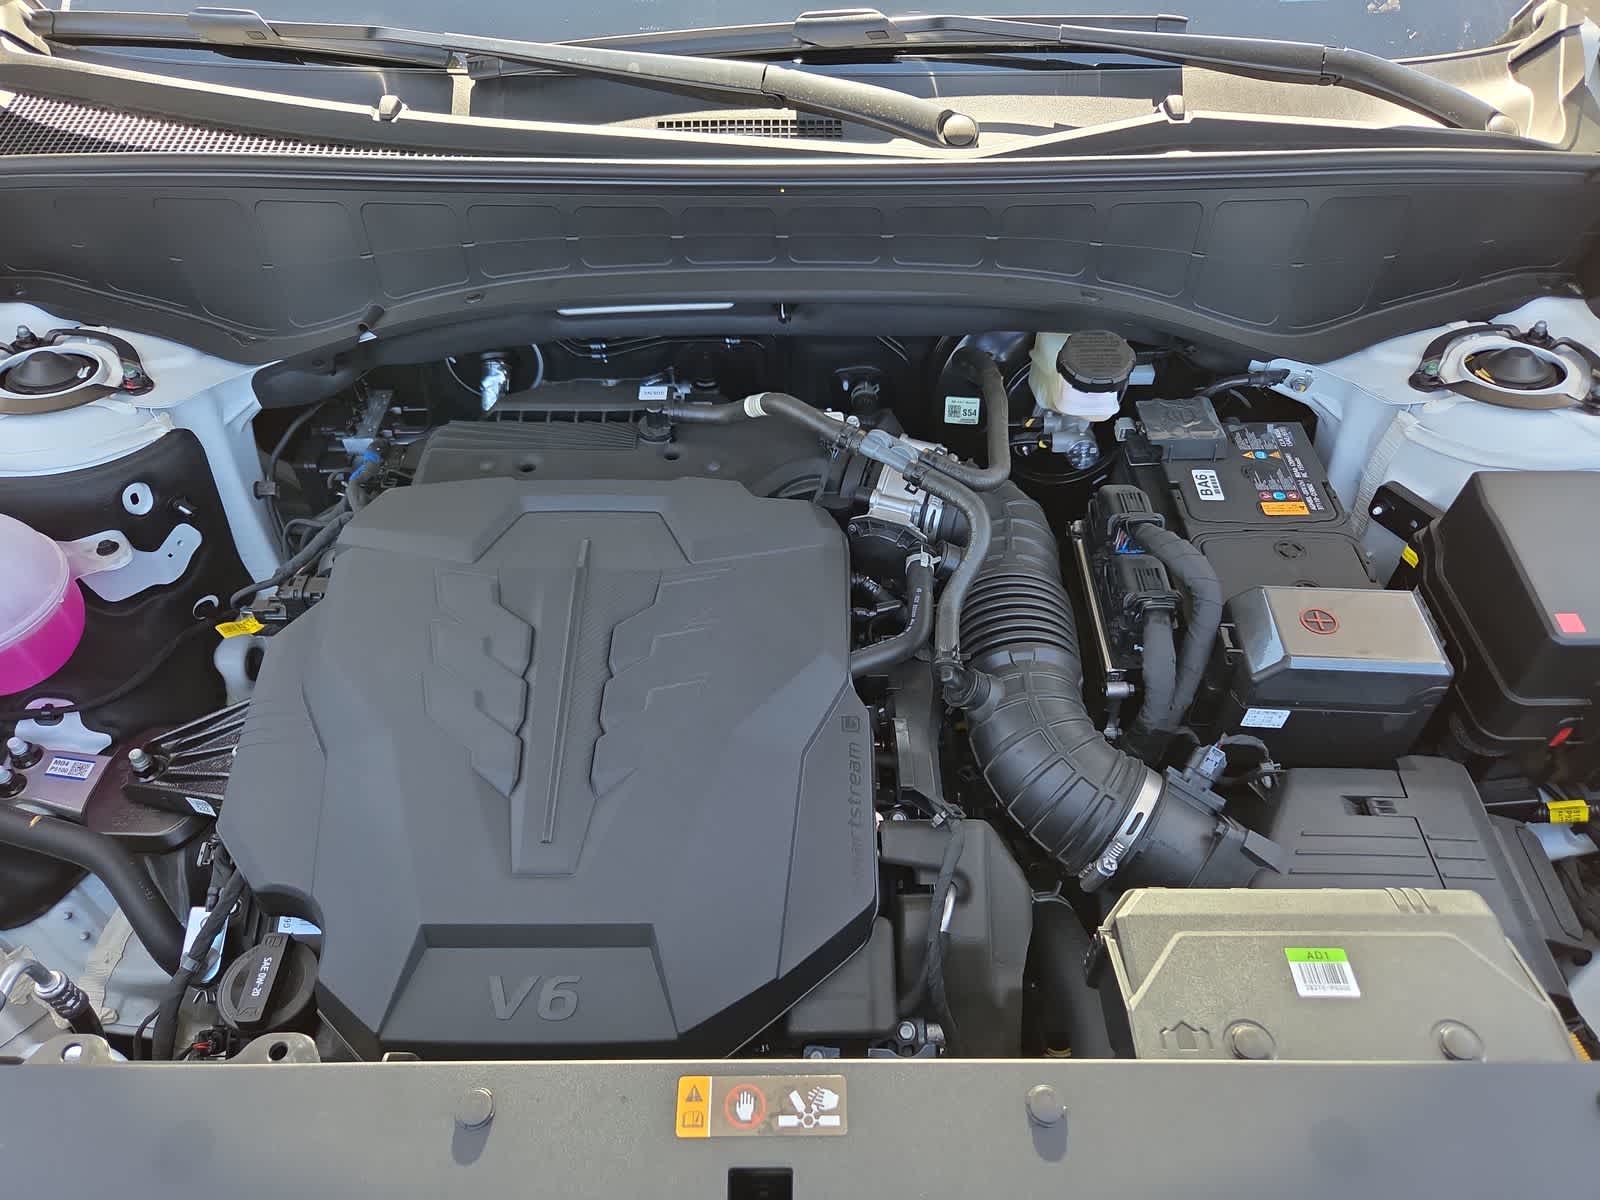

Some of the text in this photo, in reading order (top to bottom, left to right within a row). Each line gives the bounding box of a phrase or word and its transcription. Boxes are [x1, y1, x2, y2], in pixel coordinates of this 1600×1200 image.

[962, 409, 977, 417] S54
[1195, 474, 1213, 496] BA6
[1306, 950, 1329, 960] AD1
[260, 956, 273, 972] SAE
[488, 975, 582, 1021] V6
